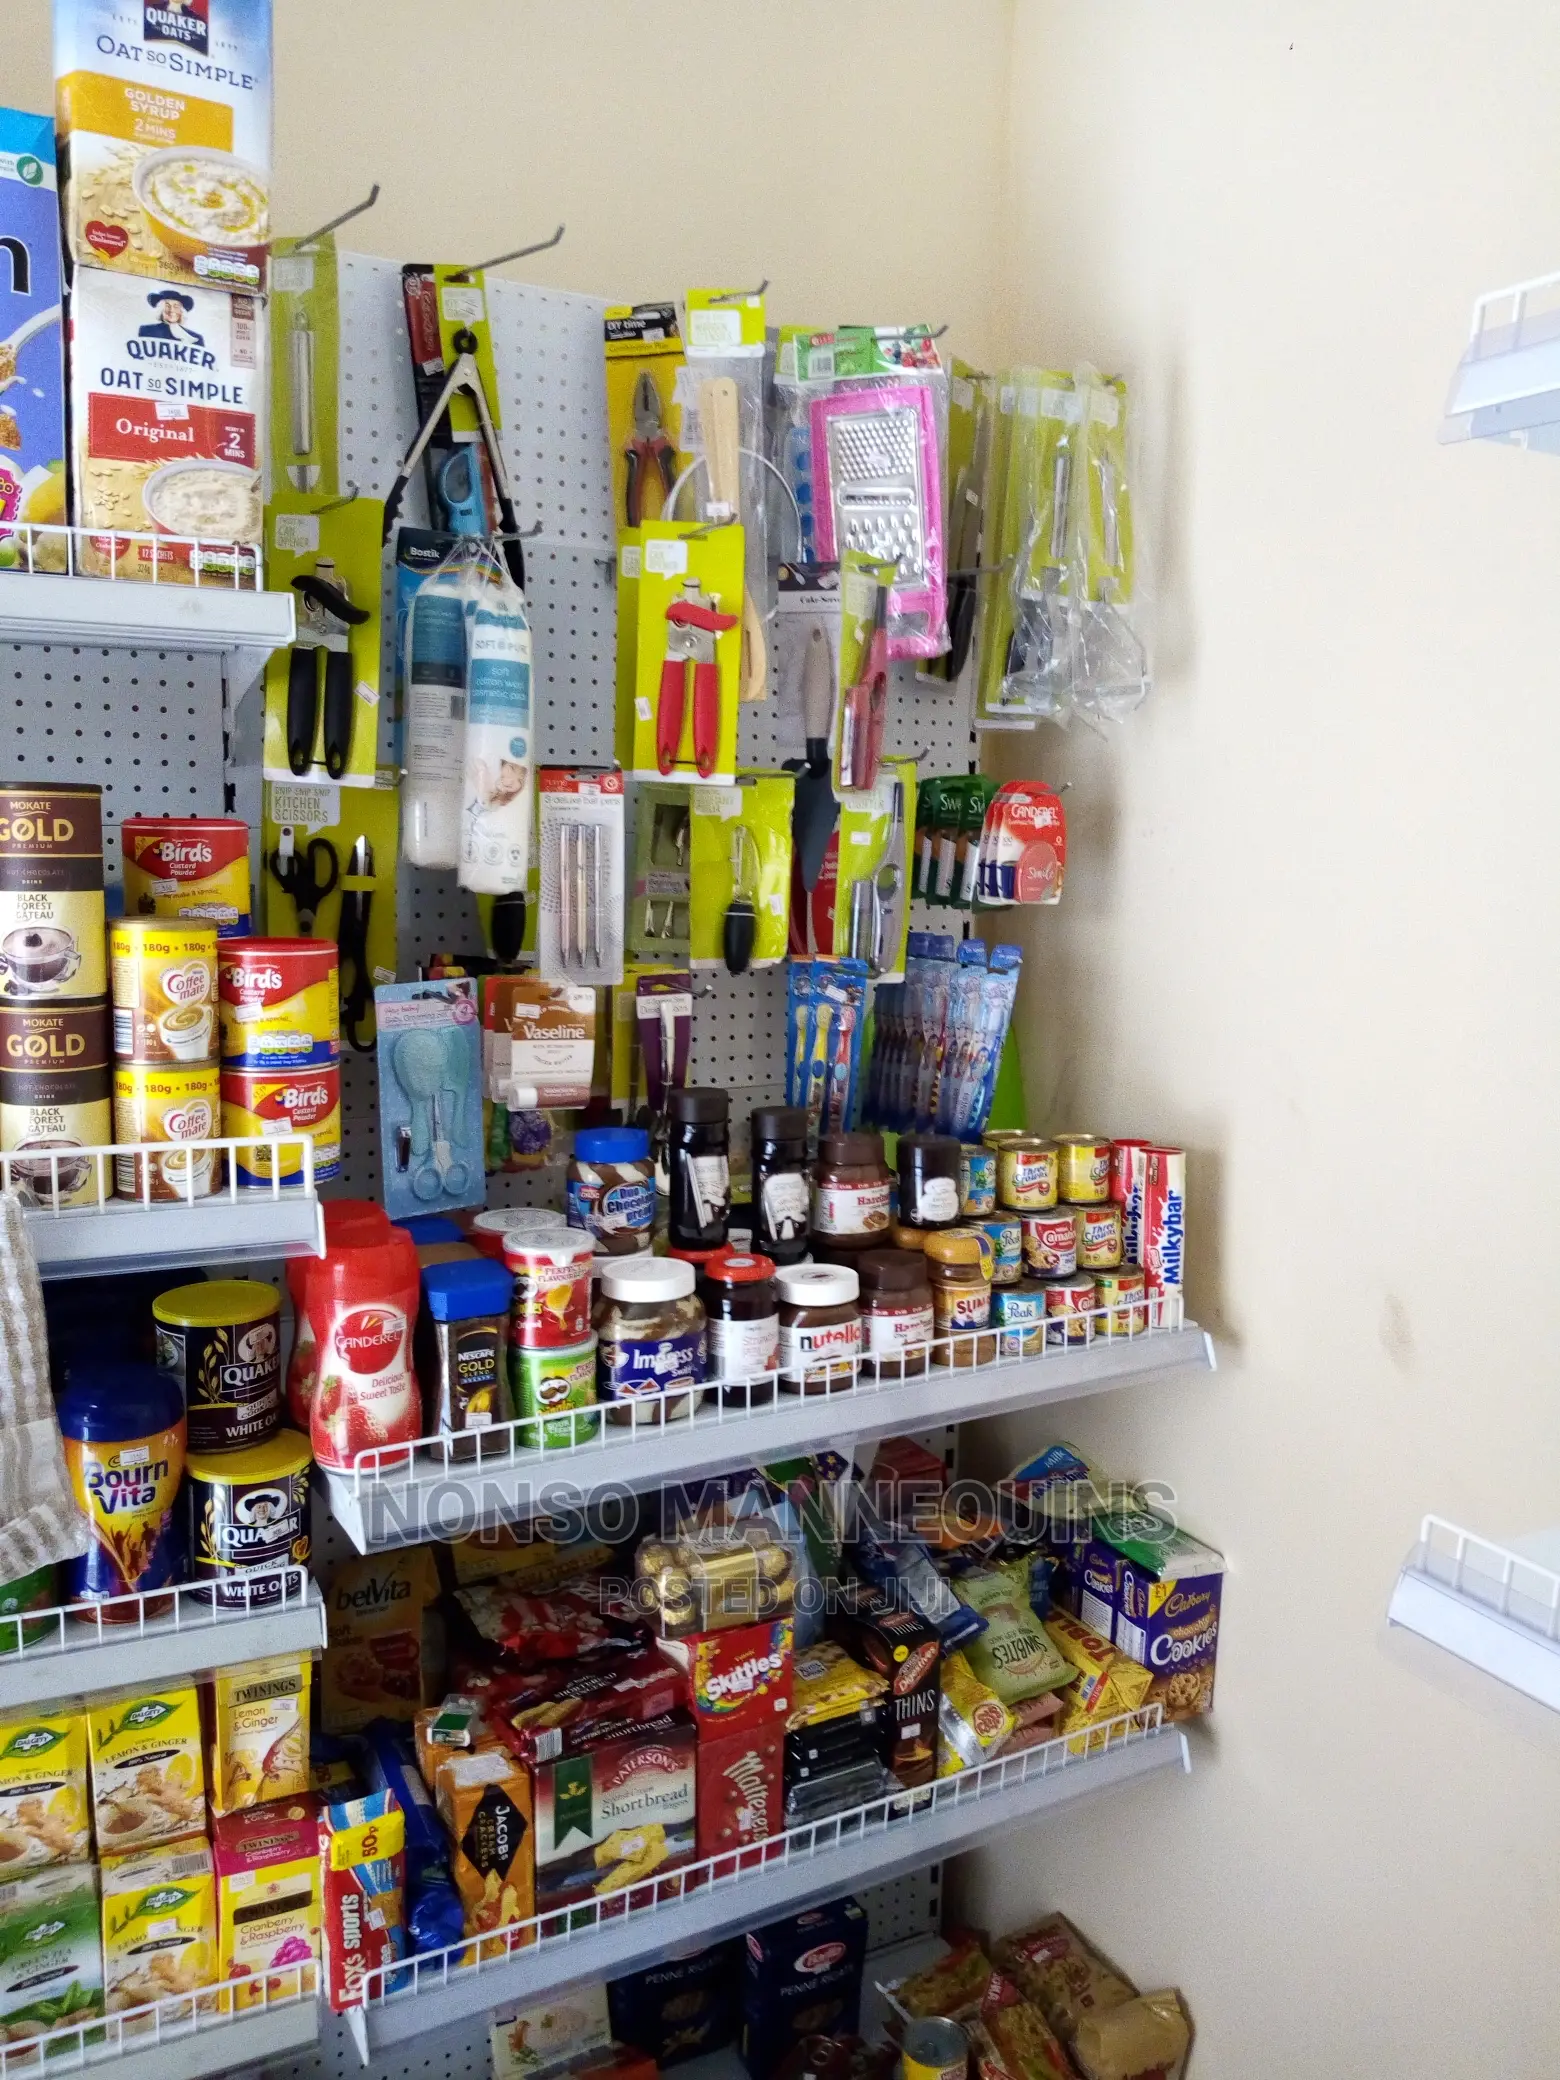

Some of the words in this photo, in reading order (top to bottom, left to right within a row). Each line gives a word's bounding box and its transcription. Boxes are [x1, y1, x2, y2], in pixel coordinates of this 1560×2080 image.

[145, 8, 207, 36] QUAKER
[161, 25, 192, 41] OATS
[96, 35, 143, 61] OAT
[147, 50, 166, 64] SO
[169, 53, 254, 90] SIMPLE
[124, 87, 185, 111] GOLDEN
[130, 103, 180, 120] SYRUP
[134, 118, 143, 131] 2
[145, 123, 176, 139] MINS
[127, 340, 216, 371] QUAKER
[101, 367, 142, 389] OAT
[147, 378, 162, 392] SO
[166, 378, 243, 405] SIMPLE
[116, 419, 195, 443] Original
[230, 433, 240, 449] 2
[224, 448, 245, 458] MINS
[150, 549, 173, 560] SCHETS
[410, 547, 441, 559] Bostik
[9, 801, 52, 810] MOKATE
[275, 797, 321, 810] KITCHEN
[275, 809, 328, 822] SCISSORS
[0, 818, 74, 841] GOLD
[161, 842, 212, 863] Bird's
[169, 862, 196, 870] Custard
[17, 894, 48, 902] BLACK
[17, 902, 52, 911] FOREST
[113, 941, 131, 953] 180g
[143, 943, 171, 954] 180g
[183, 942, 206, 953] 180g
[167, 974, 205, 994] Coffee
[232, 967, 282, 989] Bird's
[179, 986, 205, 1000] mate
[23, 1018, 64, 1028] MOKATE
[523, 1024, 586, 1040] Vaseline
[6, 1033, 86, 1058] GOLD
[115, 1081, 133, 1094] 180g
[144, 1083, 172, 1094] 180g
[184, 1081, 207, 1092] 180g
[284, 1087, 328, 1108] Bird's
[29, 1108, 60, 1116] BLACK
[292, 1107, 317, 1115] Custard
[293, 1113, 317, 1121] Powder
[29, 1116, 64, 1125] FOREST
[168, 1113, 206, 1133] Coffee
[181, 1124, 207, 1139] mate
[619, 1187, 641, 1199] Duo
[1092, 1223, 1115, 1234] Three
[1161, 1190, 1183, 1284] Milkybar
[1007, 1300, 1033, 1318] Peak
[336, 1333, 400, 1348] CANDEREL
[800, 1323, 861, 1350] nutella
[458, 1359, 495, 1374] GOLD
[464, 1369, 490, 1378] BLEND
[372, 1373, 404, 1388] Delicious
[360, 1389, 387, 1401] Sweet
[389, 1381, 406, 1395] Taste
[226, 1420, 264, 1438] WHITE
[1045, 1450, 1066, 1467] Milk
[84, 1459, 169, 1489] Bourn
[97, 1484, 156, 1514] Vita
[222, 1518, 298, 1547] QUAR
[245, 1560, 277, 1573] QUICK
[225, 1580, 267, 1597] WHITE
[336, 1571, 411, 1611] belVita
[1165, 1591, 1211, 1618] Cadbury
[890, 1620, 924, 1636] THINS
[1150, 1621, 1217, 1666] Cookies
[992, 1635, 1048, 1670] SUNBITES
[706, 1651, 782, 1701] Skittles
[234, 1679, 296, 1702] TWININGS
[131, 1708, 161, 1719] DALGETY
[233, 1706, 266, 1719] Lemon
[894, 1689, 936, 1721] THINS
[233, 1721, 241, 1732] &
[242, 1715, 279, 1730] Ginger
[17, 1736, 49, 1747] DALGETY
[104, 1747, 139, 1764] LEMON
[150, 1738, 188, 1749] GINGER
[35, 1769, 73, 1779] GINGER
[601, 1783, 688, 1820] Shortbread
[723, 1750, 770, 1841] Maltesers
[243, 1833, 295, 1850] TWININGS
[361, 1826, 378, 1858] 50p
[478, 1811, 489, 1868] CRACKERS
[241, 1917, 295, 1934] Cranberry
[339, 1894, 363, 1950] sports
[118, 1932, 148, 1952] LEMO
[240, 1936, 248, 1945] &
[249, 1923, 305, 1941] Raspberry
[645, 1969, 685, 1985] PENNE
[780, 1981, 818, 1996] PENNE
